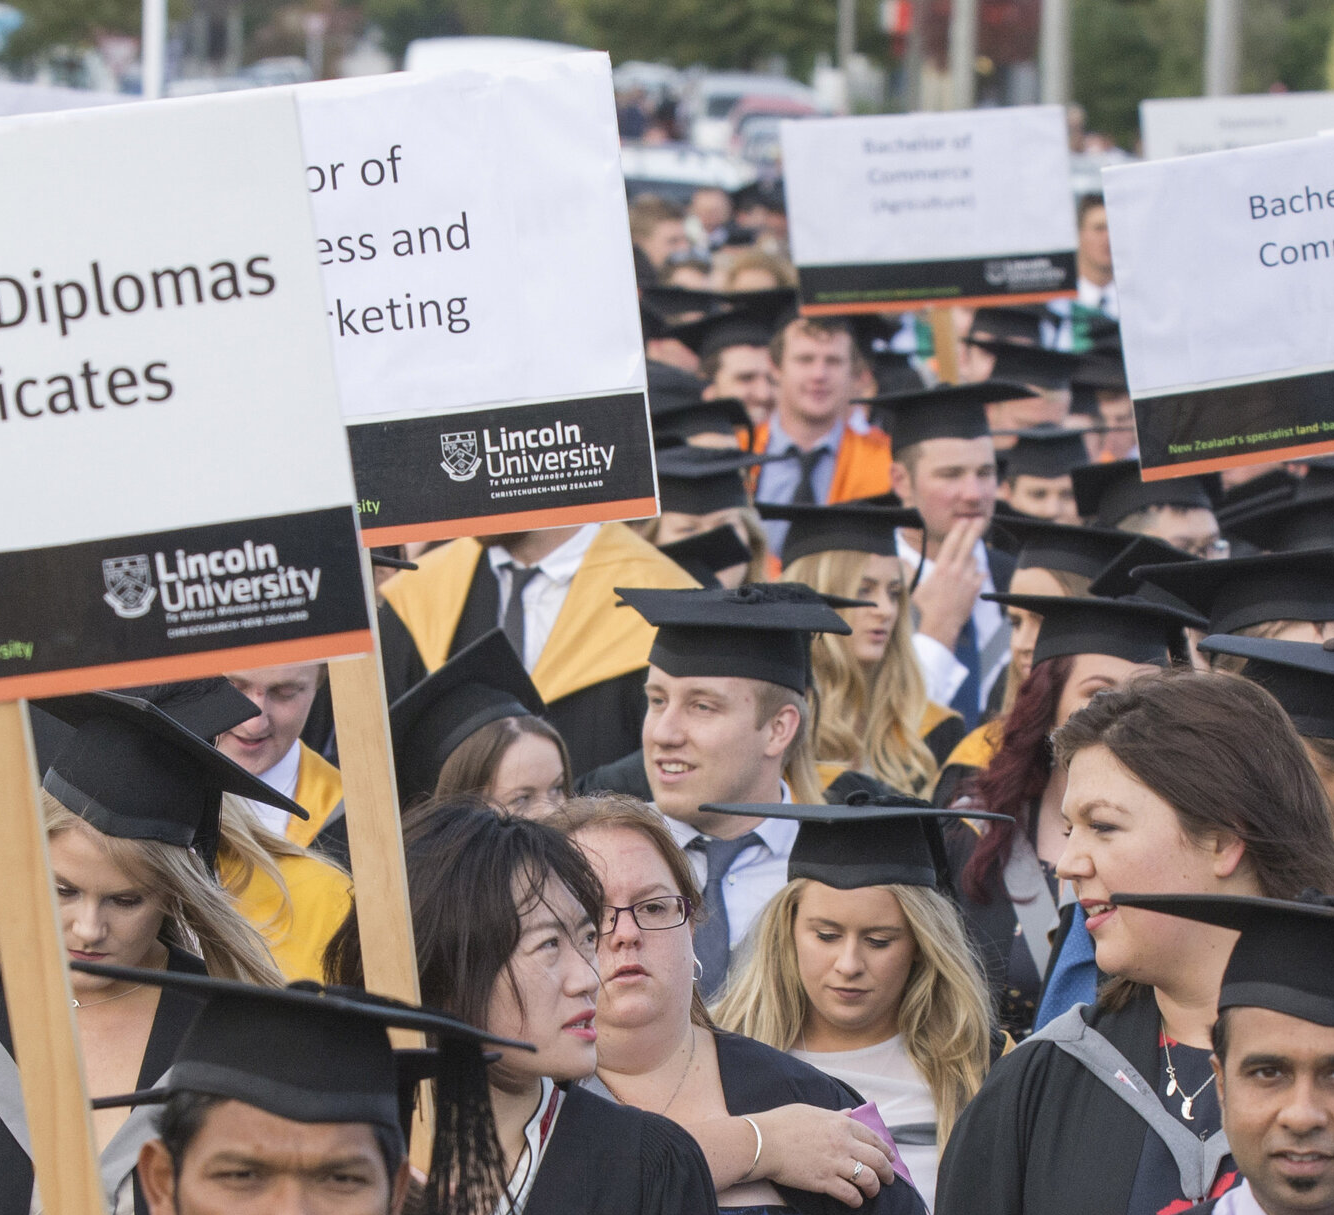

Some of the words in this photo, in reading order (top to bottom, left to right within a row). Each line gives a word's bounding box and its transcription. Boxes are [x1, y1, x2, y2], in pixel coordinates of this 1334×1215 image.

[952, 131, 972, 150] of
[361, 145, 401, 186] of
[393, 212, 469, 256] and
[327, 293, 470, 336] keting
[483, 421, 580, 452] Lincoln
[1168, 445, 1192, 453] New
[1195, 436, 1244, 450] Zealand's
[1246, 428, 1294, 443] specialist
[487, 443, 614, 477] University
[570, 480, 603, 489] ZEALAND
[155, 540, 278, 582] Lincoln
[160, 566, 320, 612] University
